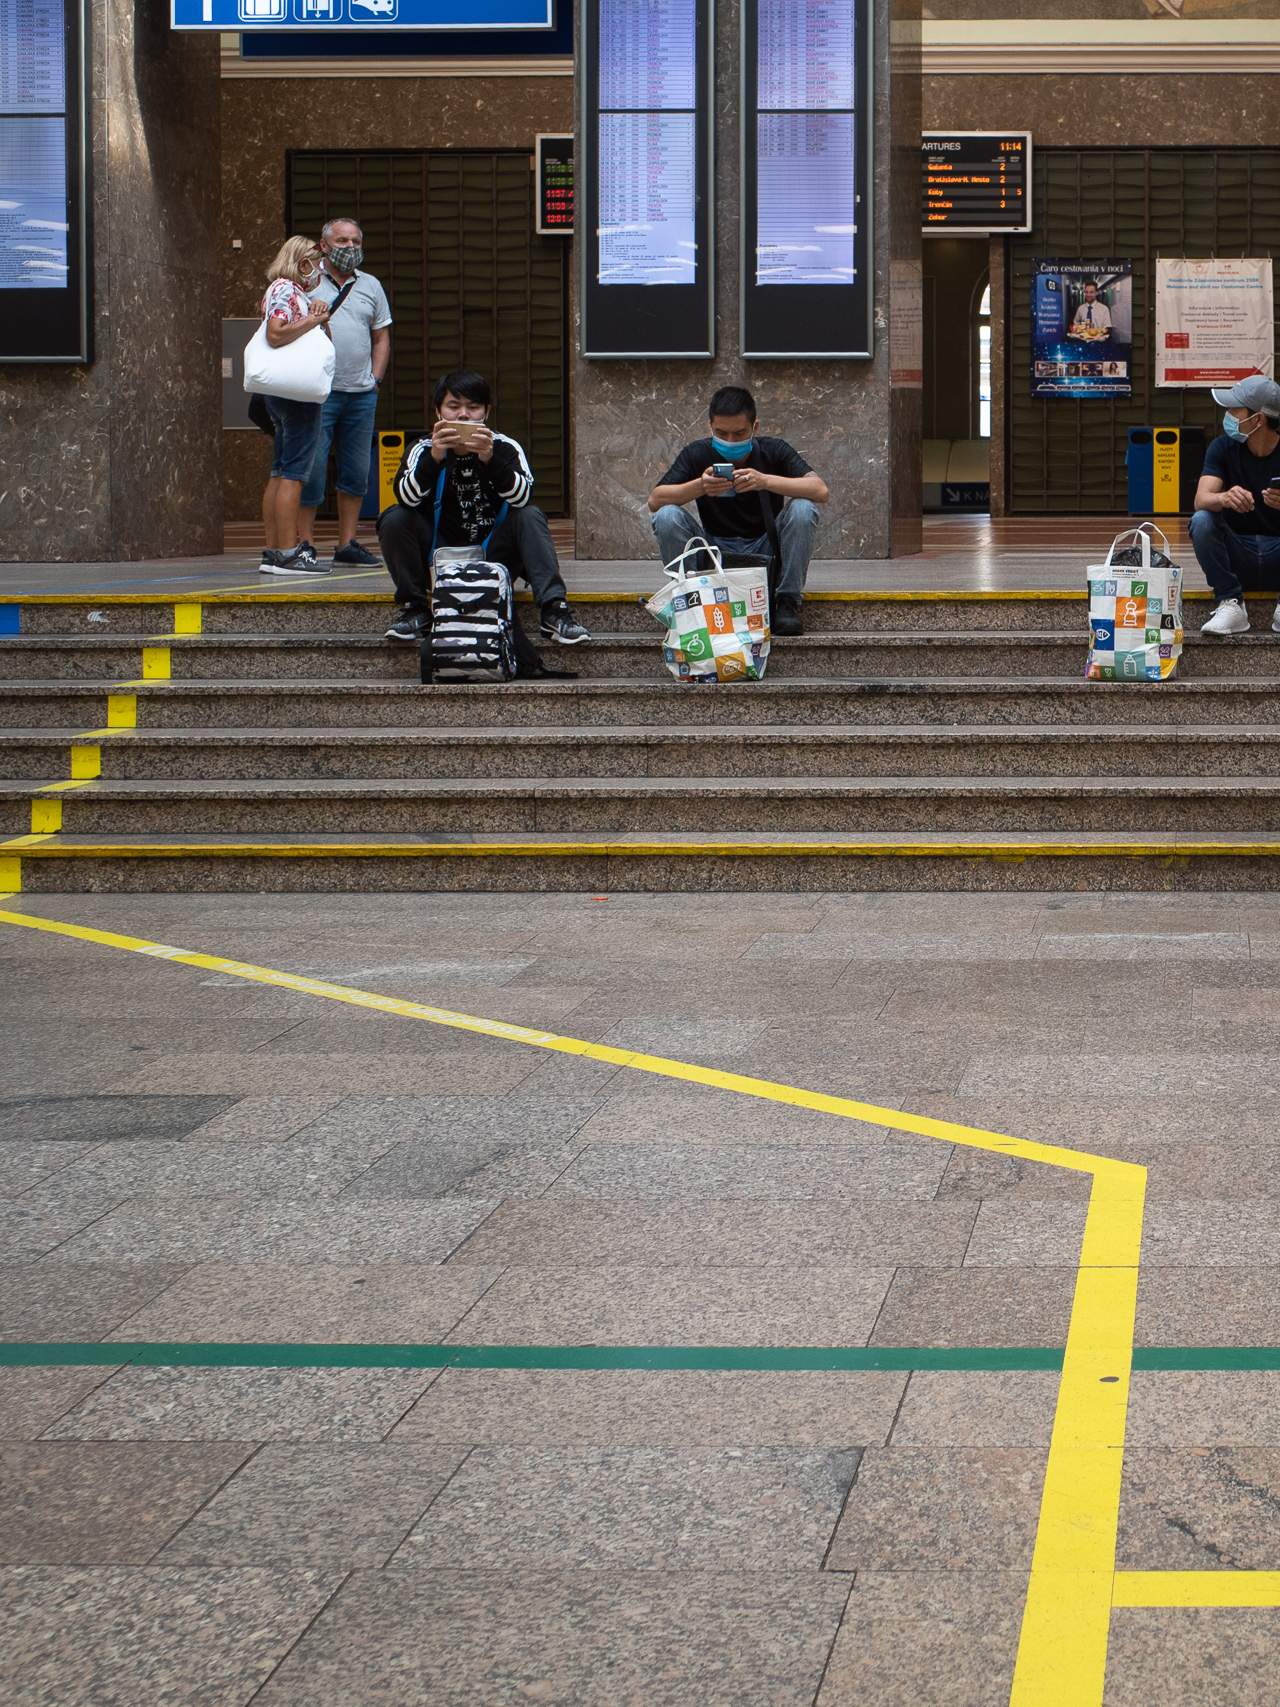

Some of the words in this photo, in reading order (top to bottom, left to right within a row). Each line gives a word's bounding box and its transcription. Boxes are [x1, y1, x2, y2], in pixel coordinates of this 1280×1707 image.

[1000, 142, 1021, 150] 11:14
[1000, 163, 1005, 171] 2
[1000, 175, 1005, 183] 2
[1000, 200, 1005, 208] 3
[1040, 263, 1058, 273] Čaro
